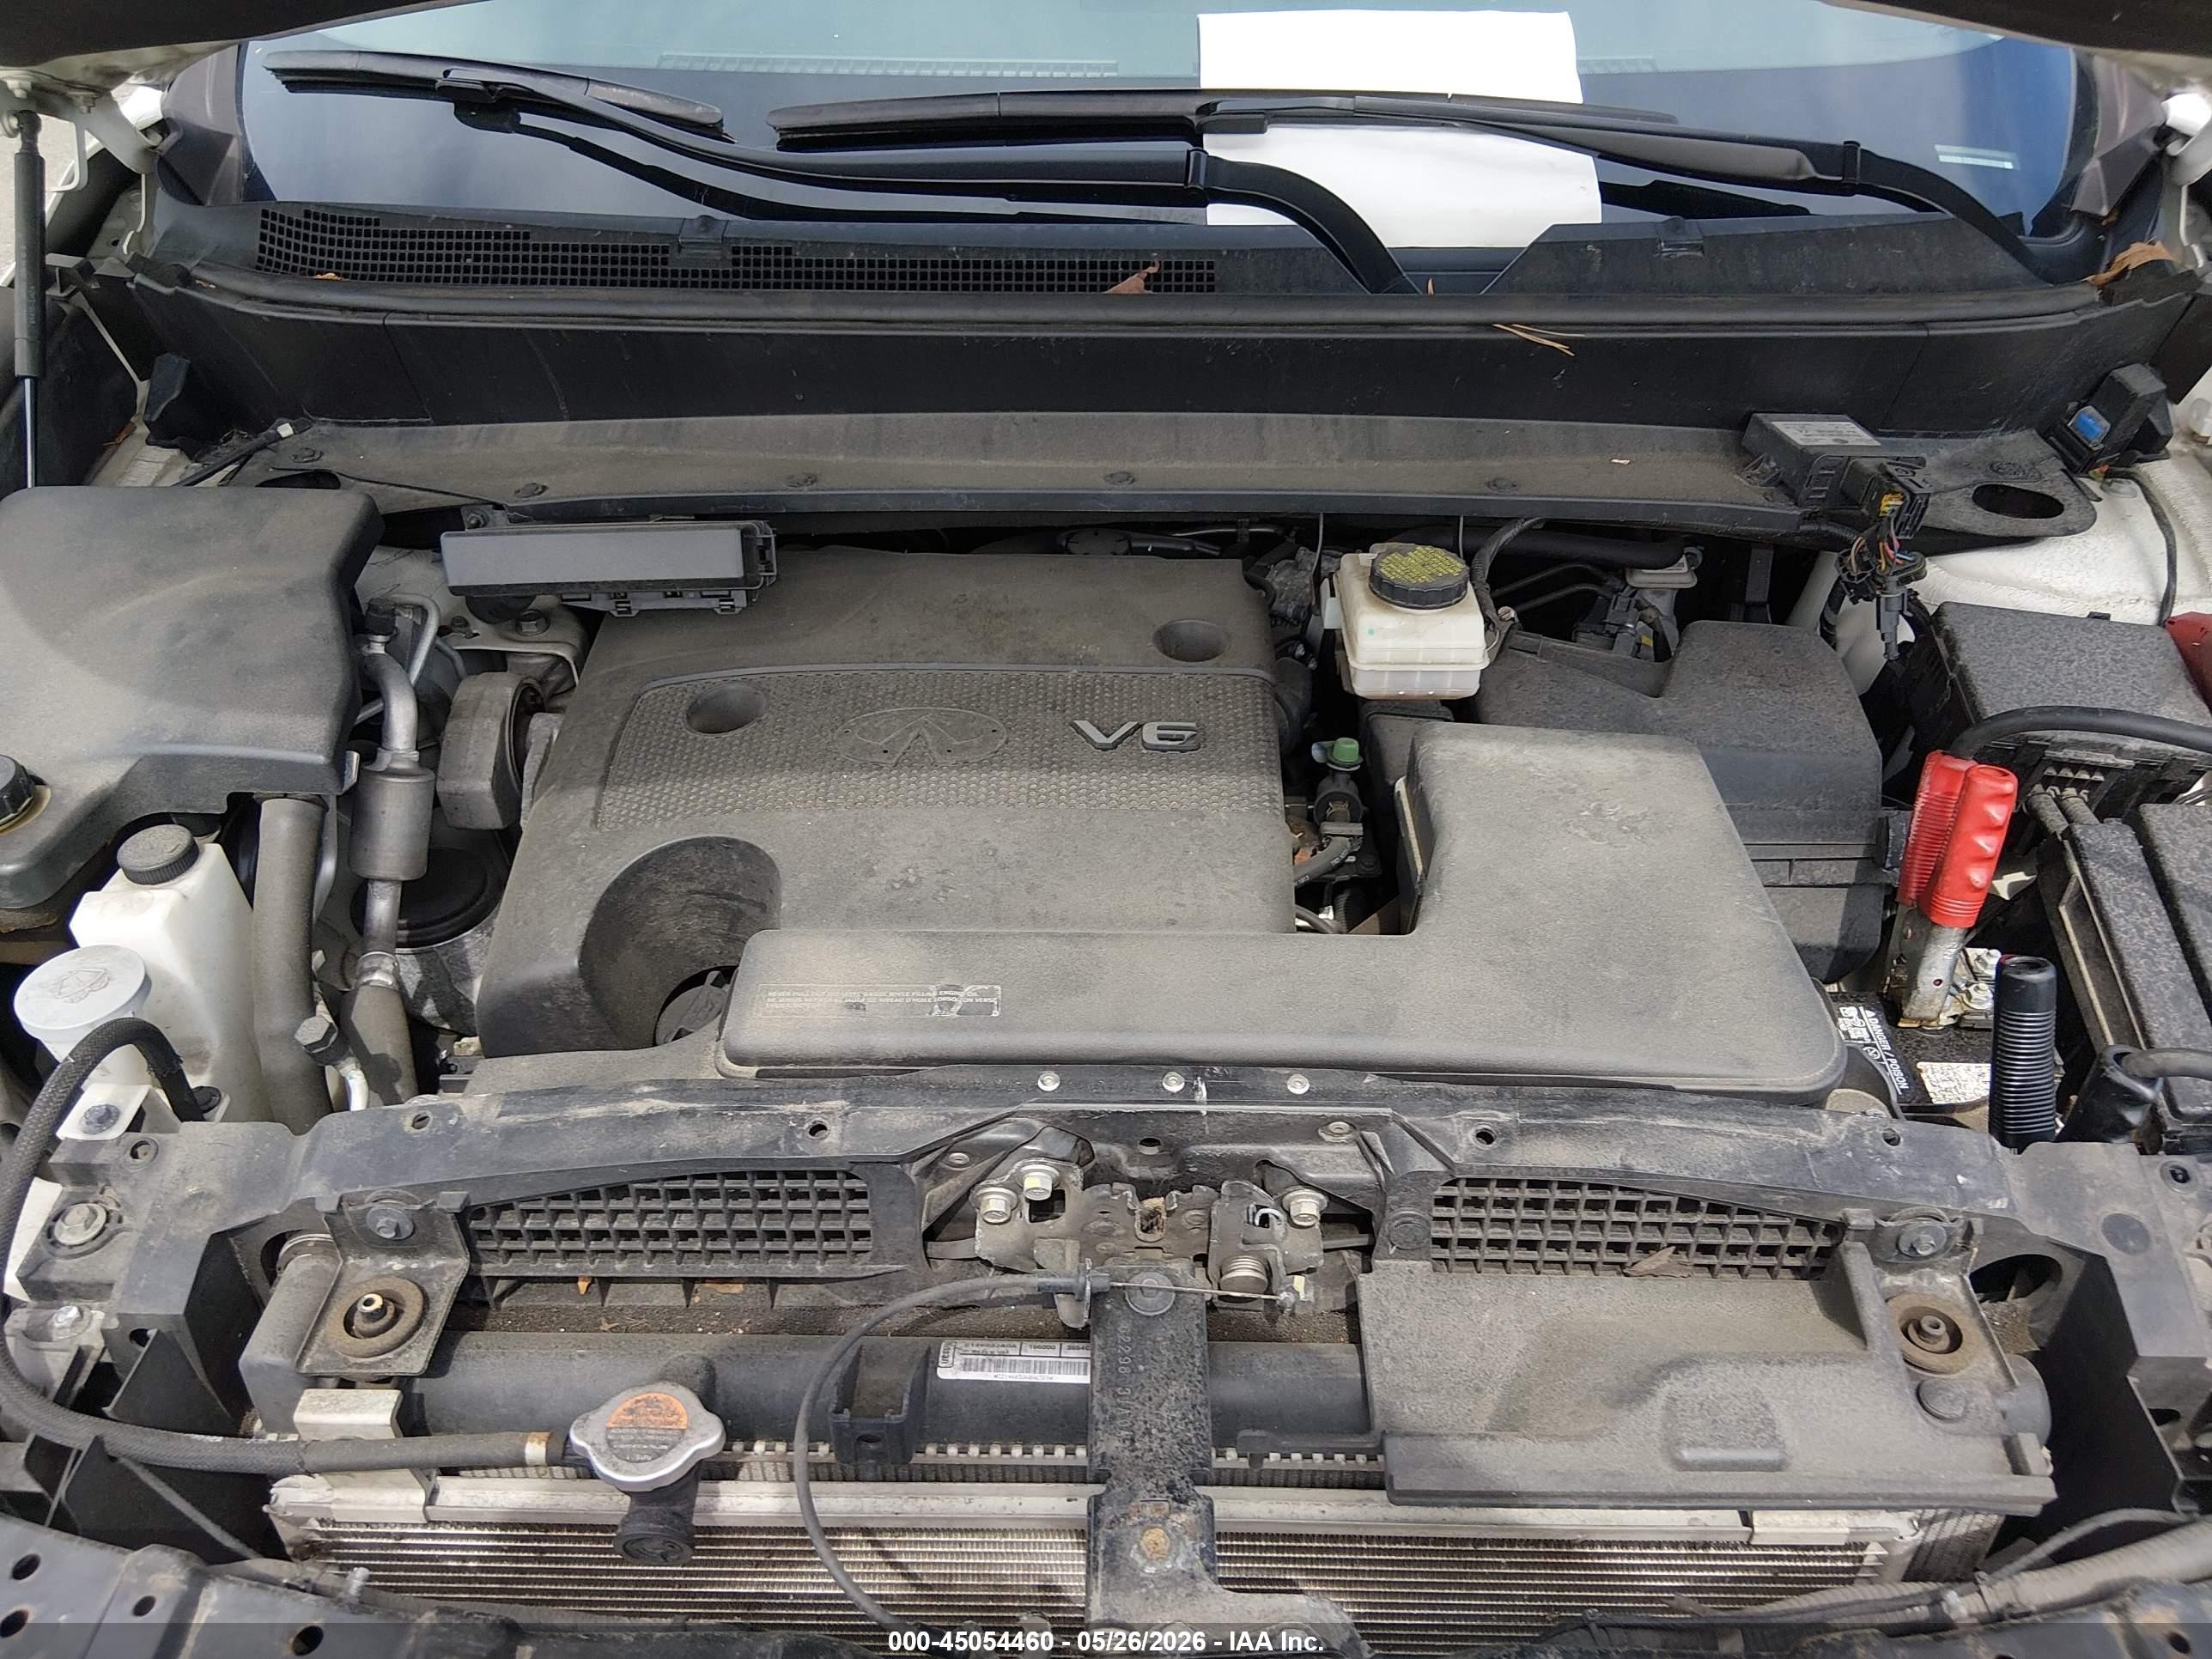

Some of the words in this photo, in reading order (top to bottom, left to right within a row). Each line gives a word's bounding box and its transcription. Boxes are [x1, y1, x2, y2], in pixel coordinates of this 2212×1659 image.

[1072, 720, 1200, 752] V6
[1869, 1018, 1891, 1055] DANGER
[1887, 1057, 1910, 1090] POISON
